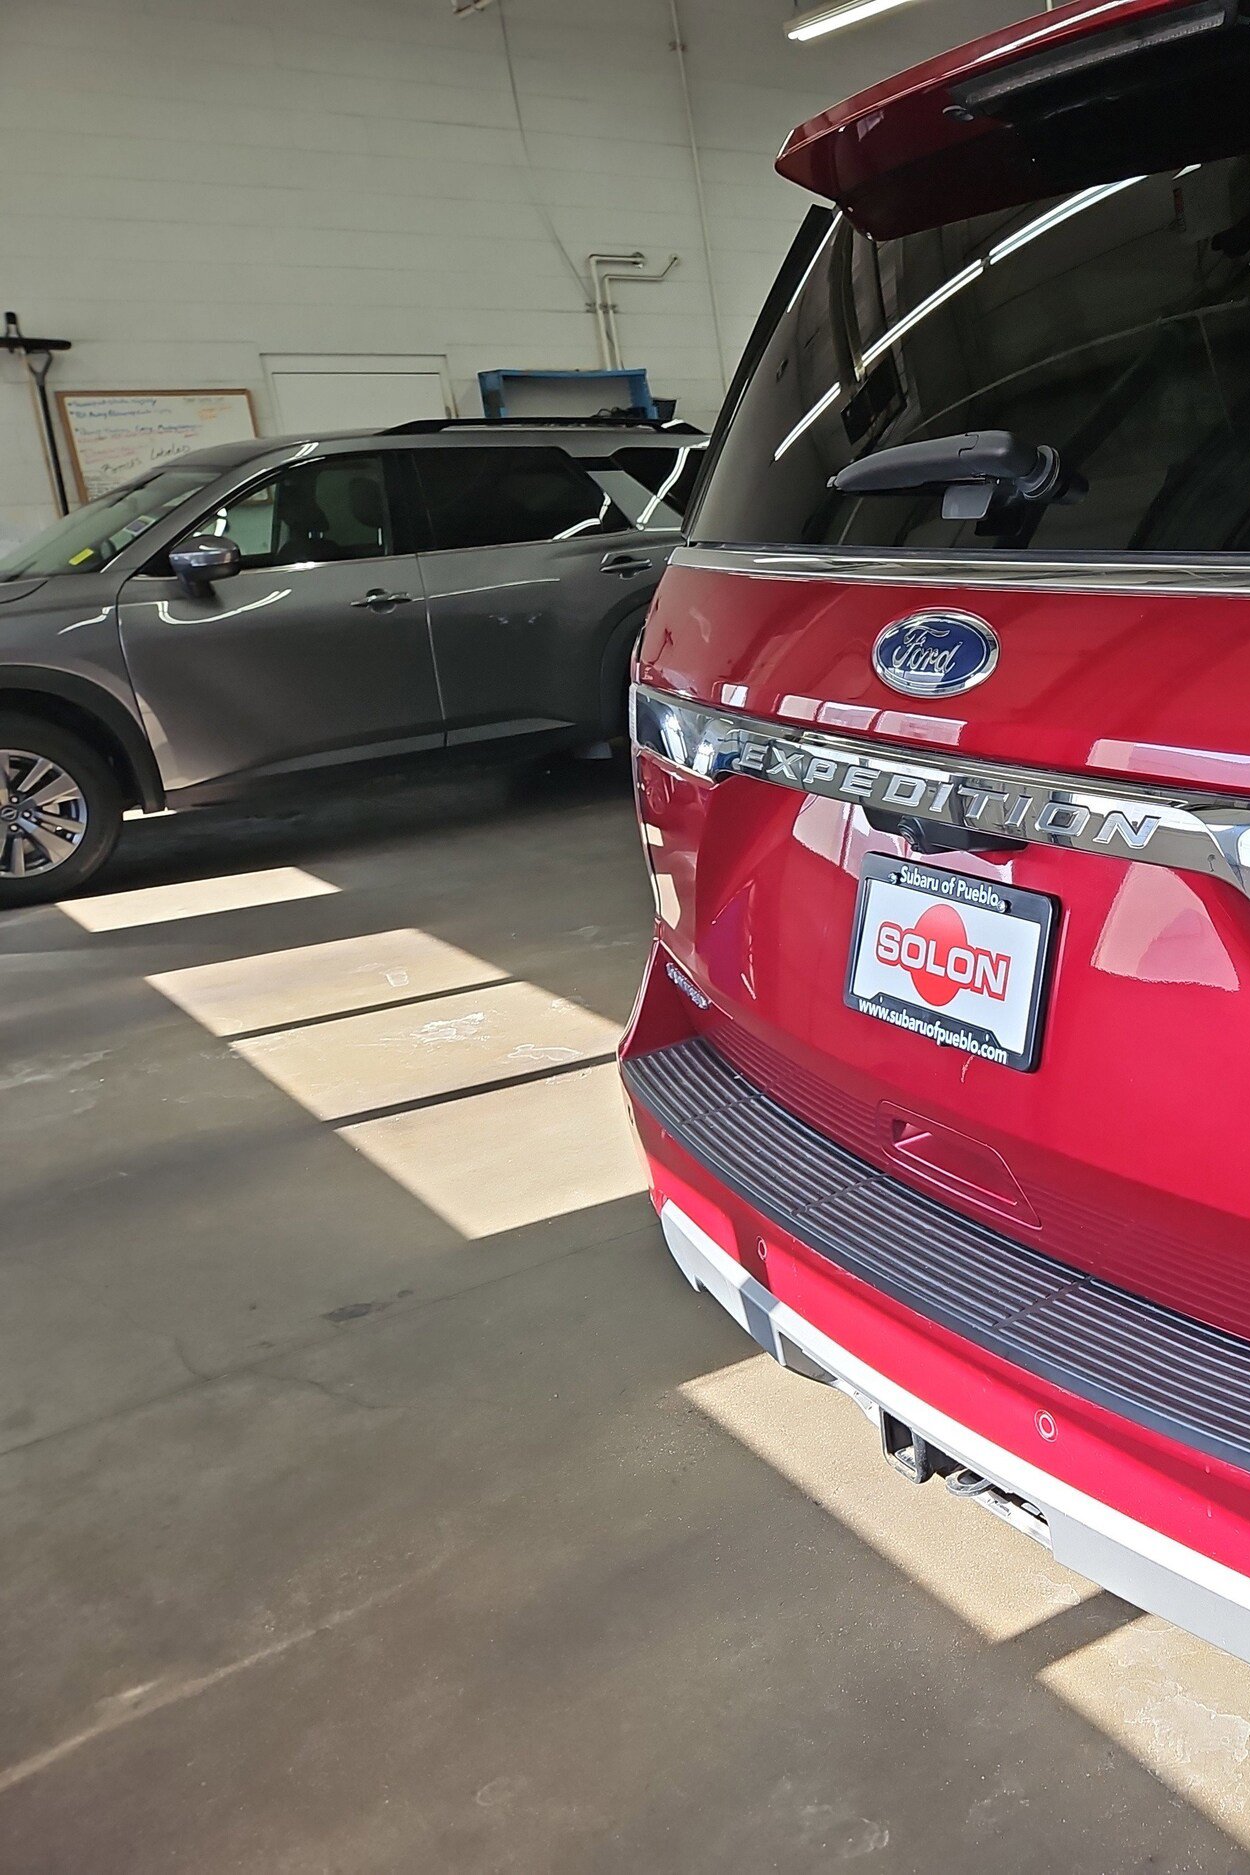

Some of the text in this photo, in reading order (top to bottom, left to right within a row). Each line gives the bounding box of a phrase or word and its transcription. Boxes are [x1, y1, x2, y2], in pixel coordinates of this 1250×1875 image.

[892, 625, 962, 674] Ford
[737, 740, 1162, 850] EXPEDITION
[900, 865, 999, 908] Subaru of Pueblo
[876, 921, 1012, 1001] SOLON
[858, 998, 1007, 1065] www.subaruofpueblo.com
